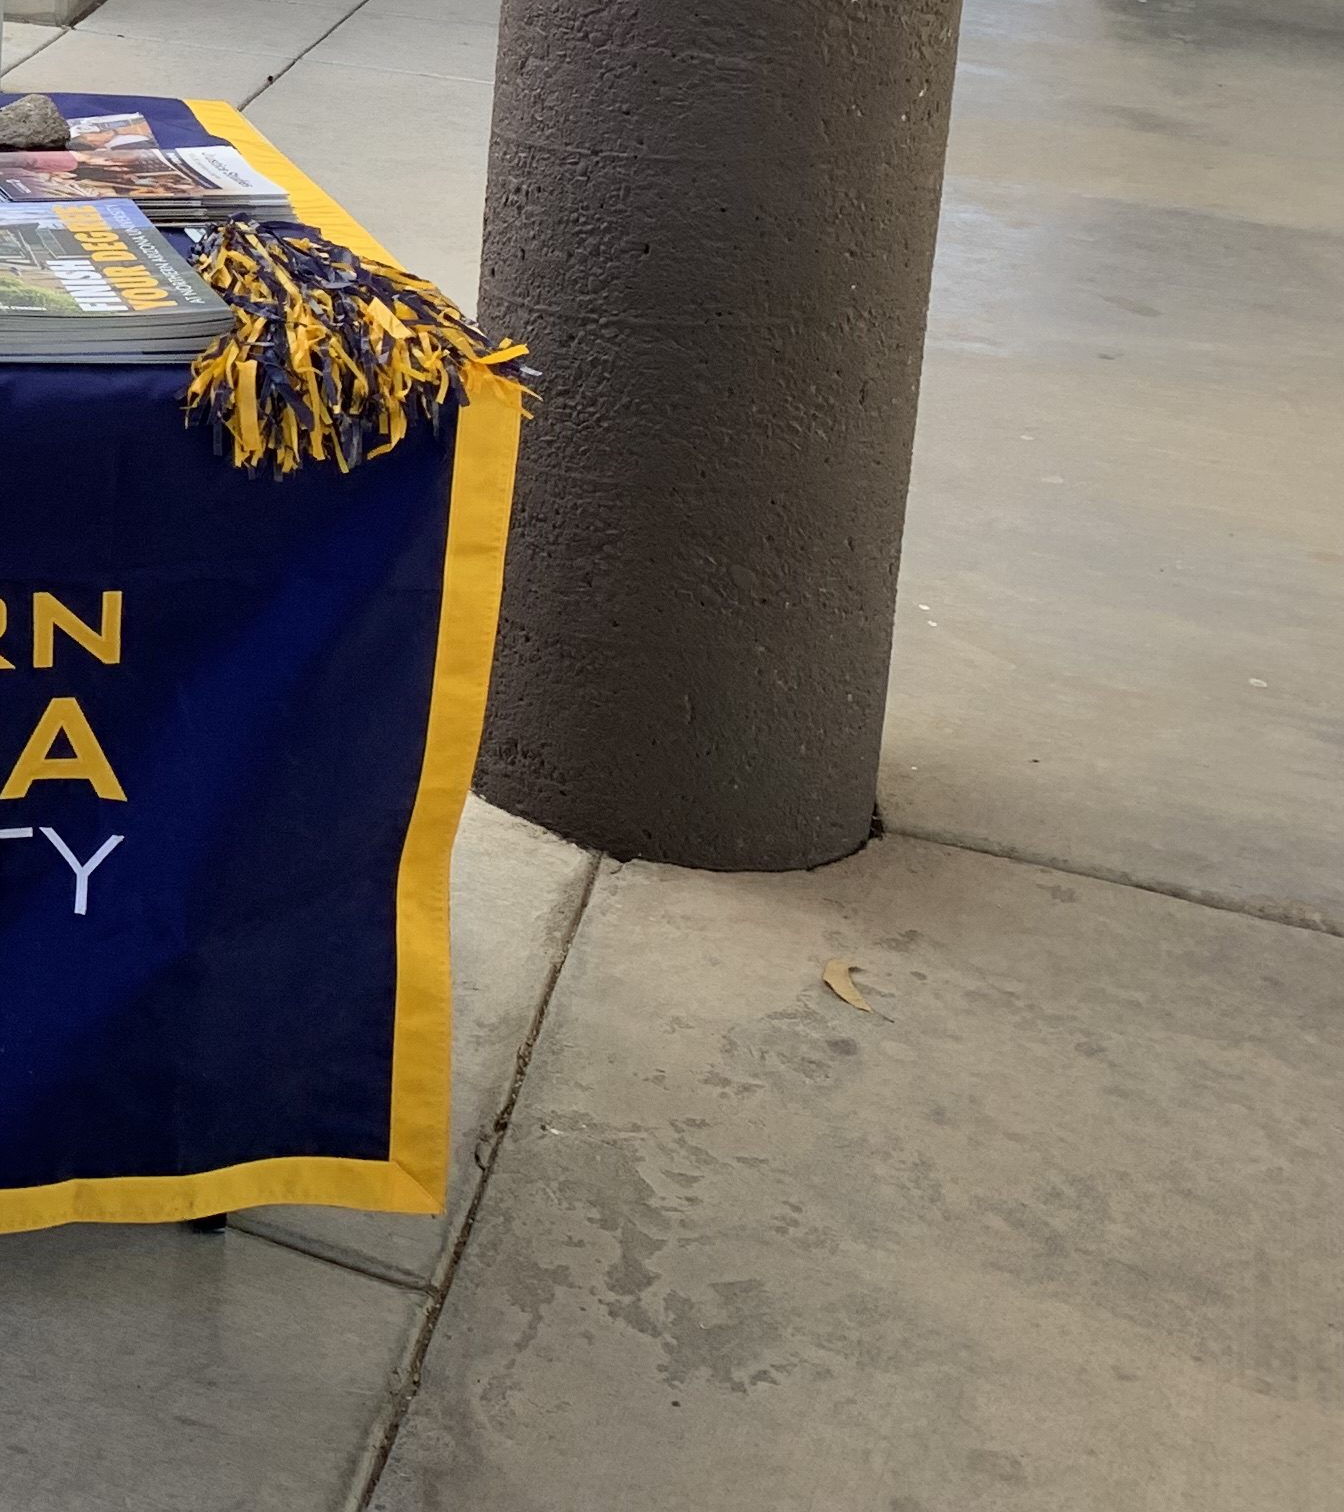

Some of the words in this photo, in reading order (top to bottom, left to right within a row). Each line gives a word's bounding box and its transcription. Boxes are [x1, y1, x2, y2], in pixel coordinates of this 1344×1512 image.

[52, 204, 138, 262] DEGREE
[46, 259, 129, 312] FINISH
[102, 264, 179, 311] YOUR
